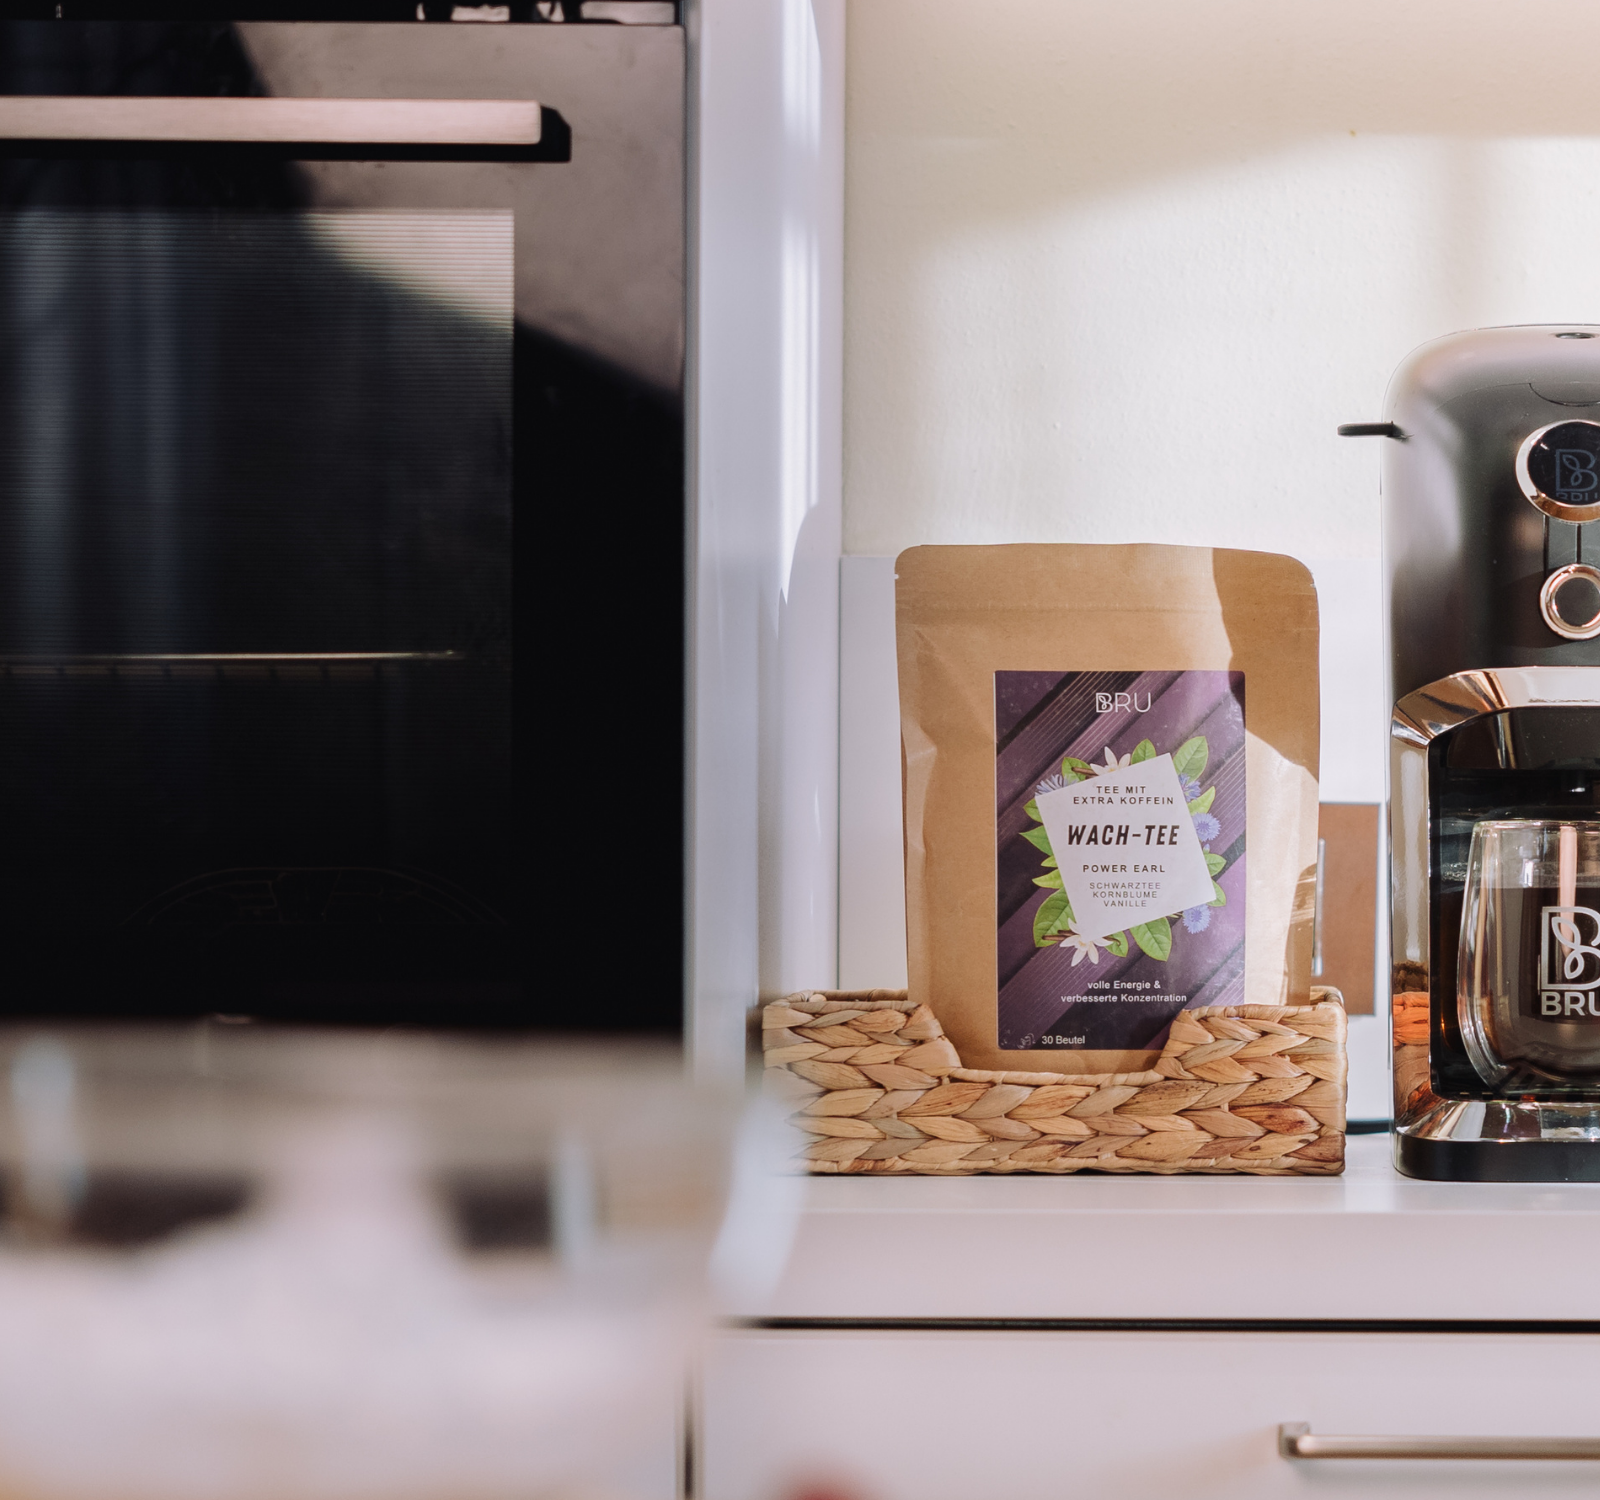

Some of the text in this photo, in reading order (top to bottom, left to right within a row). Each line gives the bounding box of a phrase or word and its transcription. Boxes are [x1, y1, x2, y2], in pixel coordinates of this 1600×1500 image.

[1096, 692, 1151, 713] BRU
[1096, 786, 1146, 794] TEE MIT
[1073, 797, 1174, 805] EXTRA KOFFEIN
[1068, 825, 1179, 845] WACH-TEE
[1082, 864, 1166, 873] POWER EARL
[1089, 882, 1161, 890] SCHWARZTEE
[1087, 980, 1161, 991] volle Energie &
[1060, 993, 1187, 1003] verbesserte Konzentration
[1041, 1035, 1086, 1045] 30 Beutel
